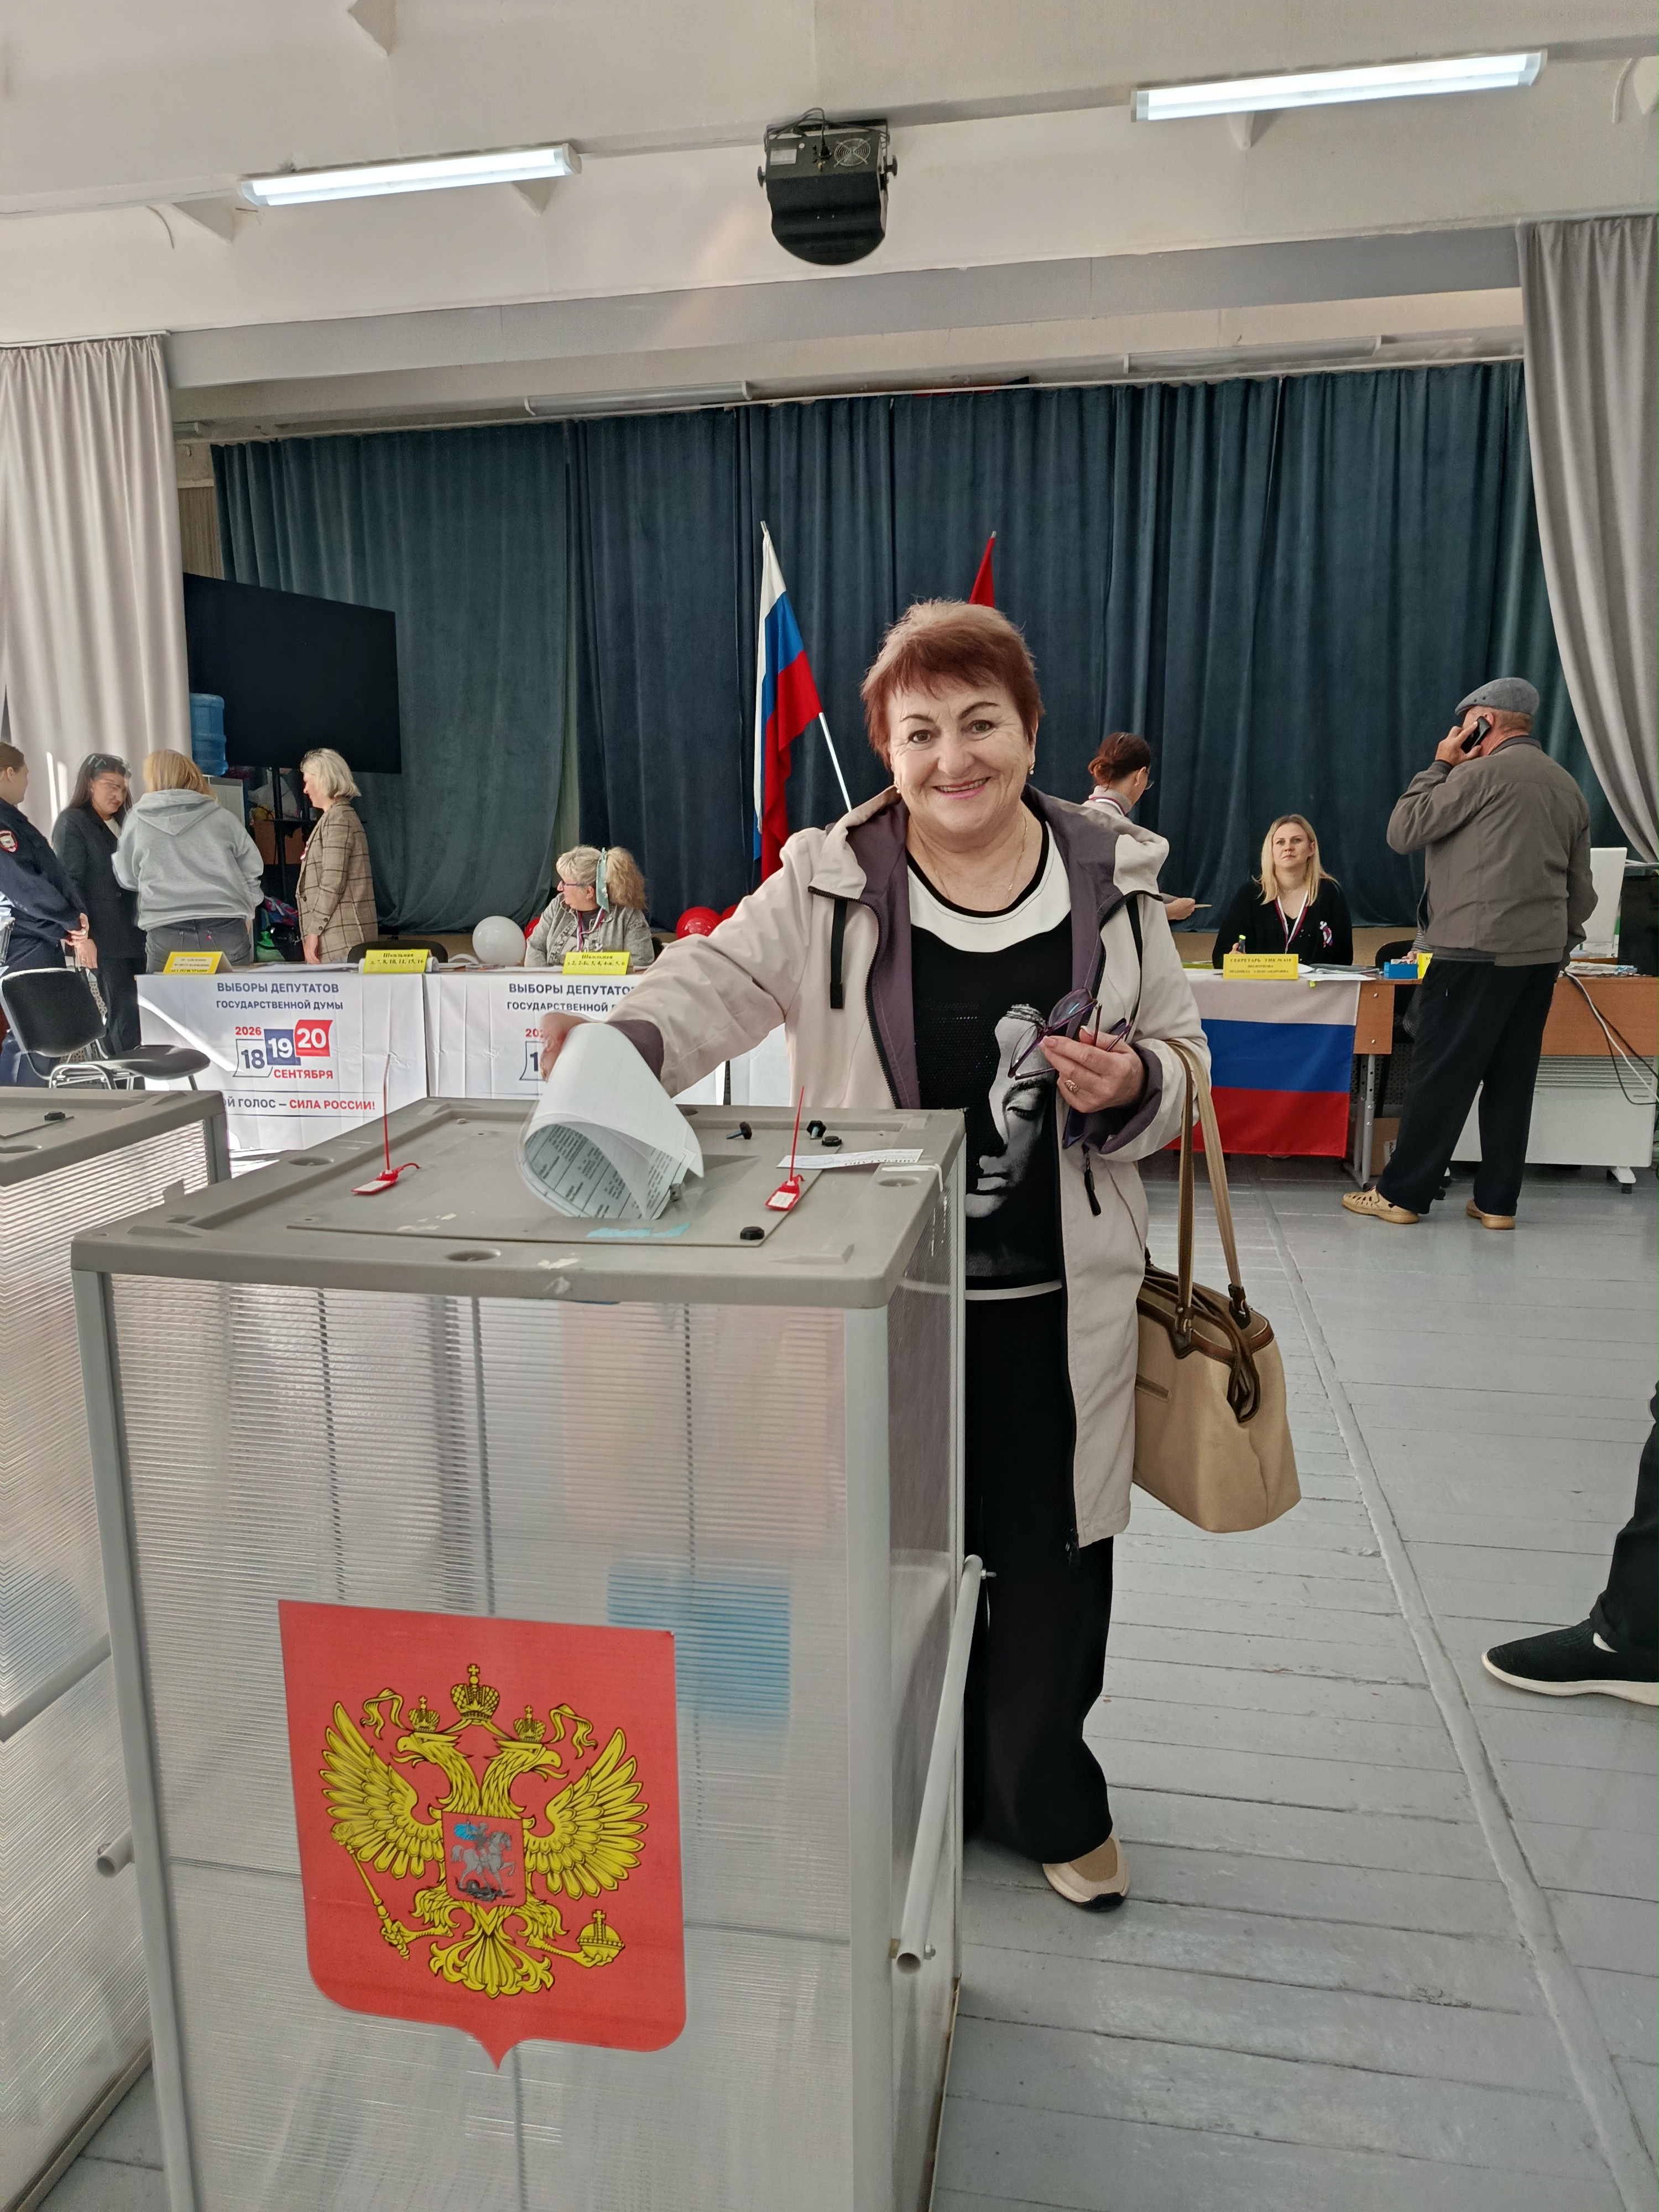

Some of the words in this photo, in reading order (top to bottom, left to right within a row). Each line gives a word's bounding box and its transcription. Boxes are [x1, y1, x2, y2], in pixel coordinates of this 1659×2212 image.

[217, 982, 268, 993] ВЫБОРЫ
[271, 983, 339, 994] ДЕПУТАТОВ
[509, 983, 563, 994] ВЫБОРЫ
[566, 984, 635, 996] ДЕПУТАТО
[216, 1000, 311, 1010] ГОСУДАРСТВЕННОЙ
[313, 1001, 343, 1011] ДУМЫ
[507, 1001, 608, 1012] ГОСУДАРСТВЕННОЙ
[235, 1026, 262, 1036] 2026
[296, 1028, 327, 1048] 20
[268, 1037, 293, 1058] 19
[241, 1049, 265, 1069] 18
[274, 1069, 333, 1079] СЕНТЯБРЯ
[238, 1098, 276, 1108] ГОЛОС
[289, 1099, 321, 1109] СИЛА
[324, 1100, 375, 1110] РОССИИ!
